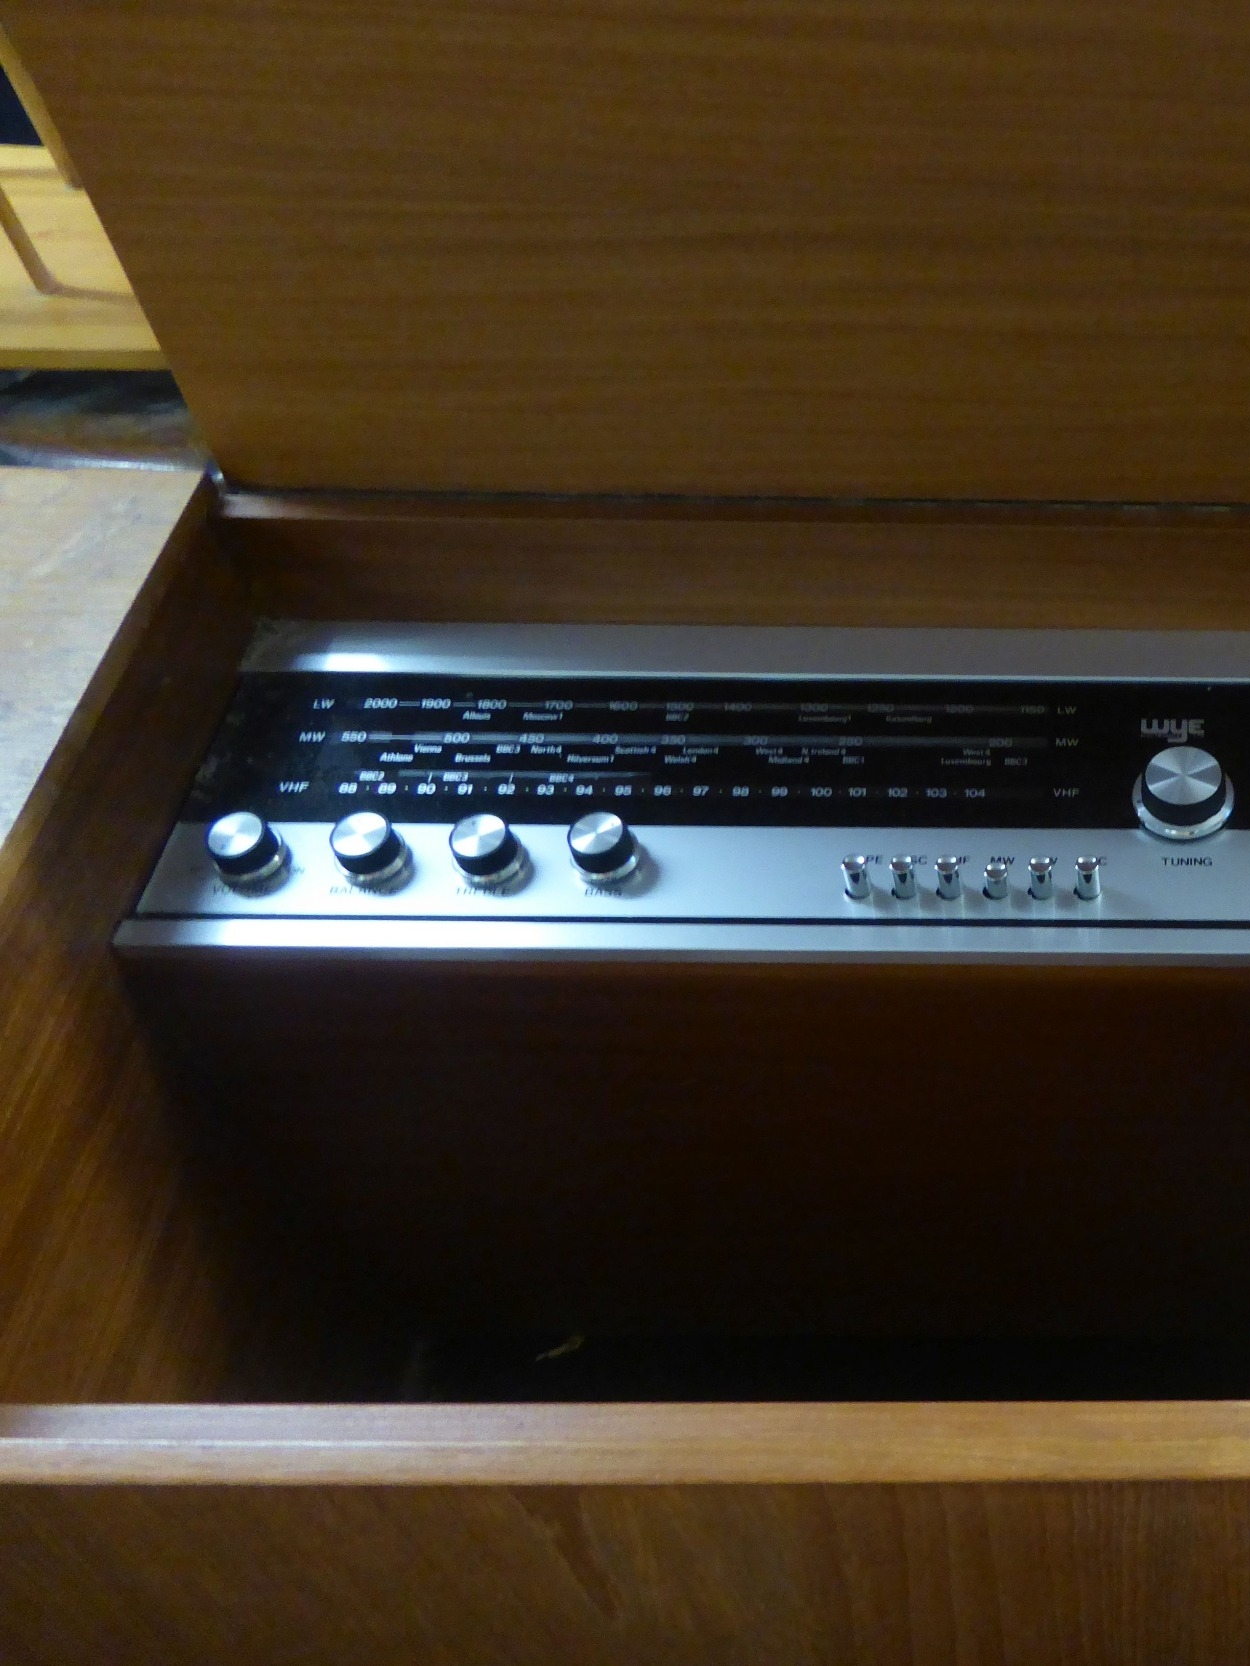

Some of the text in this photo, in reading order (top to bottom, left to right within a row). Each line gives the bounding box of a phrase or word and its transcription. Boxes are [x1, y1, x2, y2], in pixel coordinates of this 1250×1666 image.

[313, 699, 335, 710] LW
[363, 698, 398, 709] 2000
[420, 698, 452, 710] 1900
[477, 699, 507, 710] 1800
[545, 700, 574, 711] 1700
[1057, 705, 1077, 715] LW
[299, 731, 326, 742] MW
[341, 731, 367, 742] 550
[444, 732, 471, 743] 500
[593, 733, 619, 744] 400
[1055, 738, 1079, 747] MW
[414, 744, 442, 754] Vienna
[454, 753, 491, 763] Brussels
[279, 781, 1080, 798] VHF 88 89 90 91 92 93 94 95 96 97 98 99 100 101 102 103 104 VHF
[1161, 857, 1213, 867] TUNING
